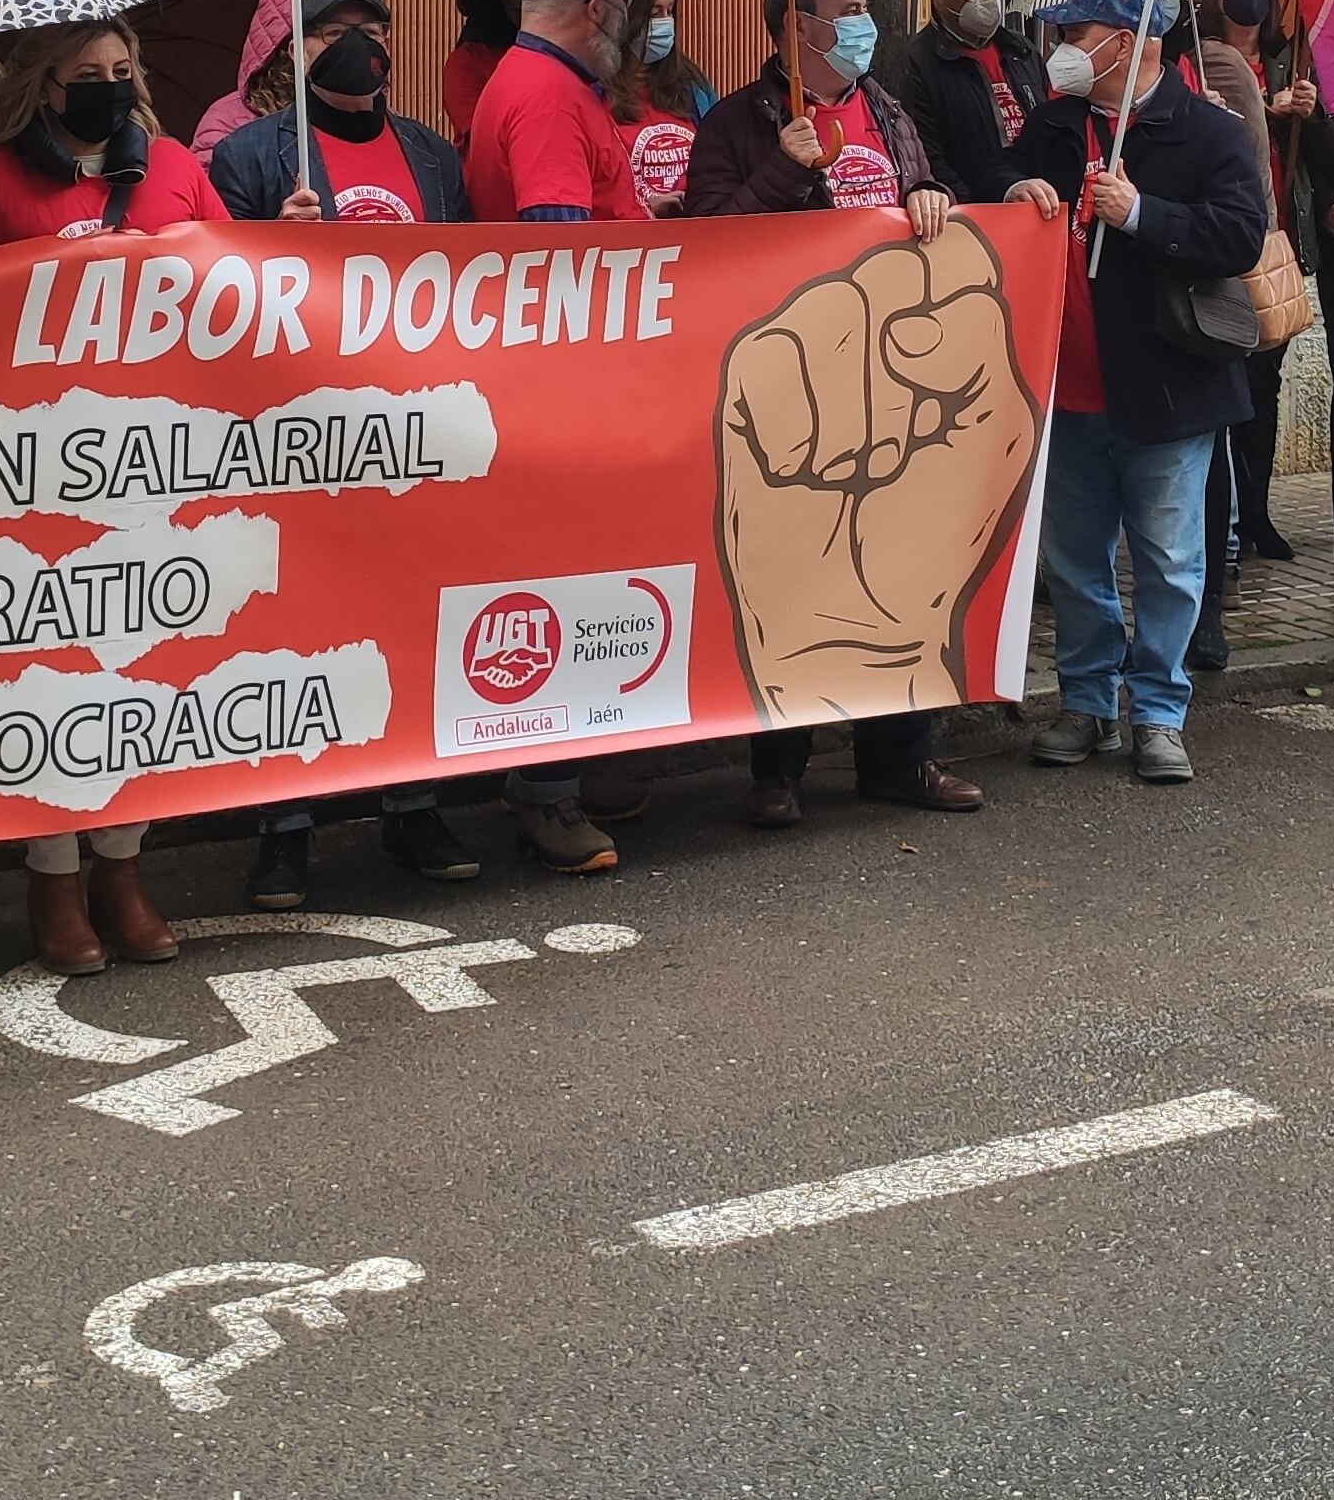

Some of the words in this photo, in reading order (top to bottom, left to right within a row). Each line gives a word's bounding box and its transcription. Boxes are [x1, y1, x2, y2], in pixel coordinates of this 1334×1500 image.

[353, 188, 383, 199] MENOS
[385, 193, 412, 223] BUROCR
[833, 190, 895, 209] ESENCIALES
[10, 253, 312, 369] LABOR
[338, 244, 684, 357] DOCENTE
[58, 409, 443, 502] SALARIAL
[475, 608, 550, 657] UGT
[574, 613, 656, 640] Servicios
[573, 637, 649, 663] Públicos
[473, 713, 553, 740] Andalucía
[586, 704, 624, 726] Jaén
